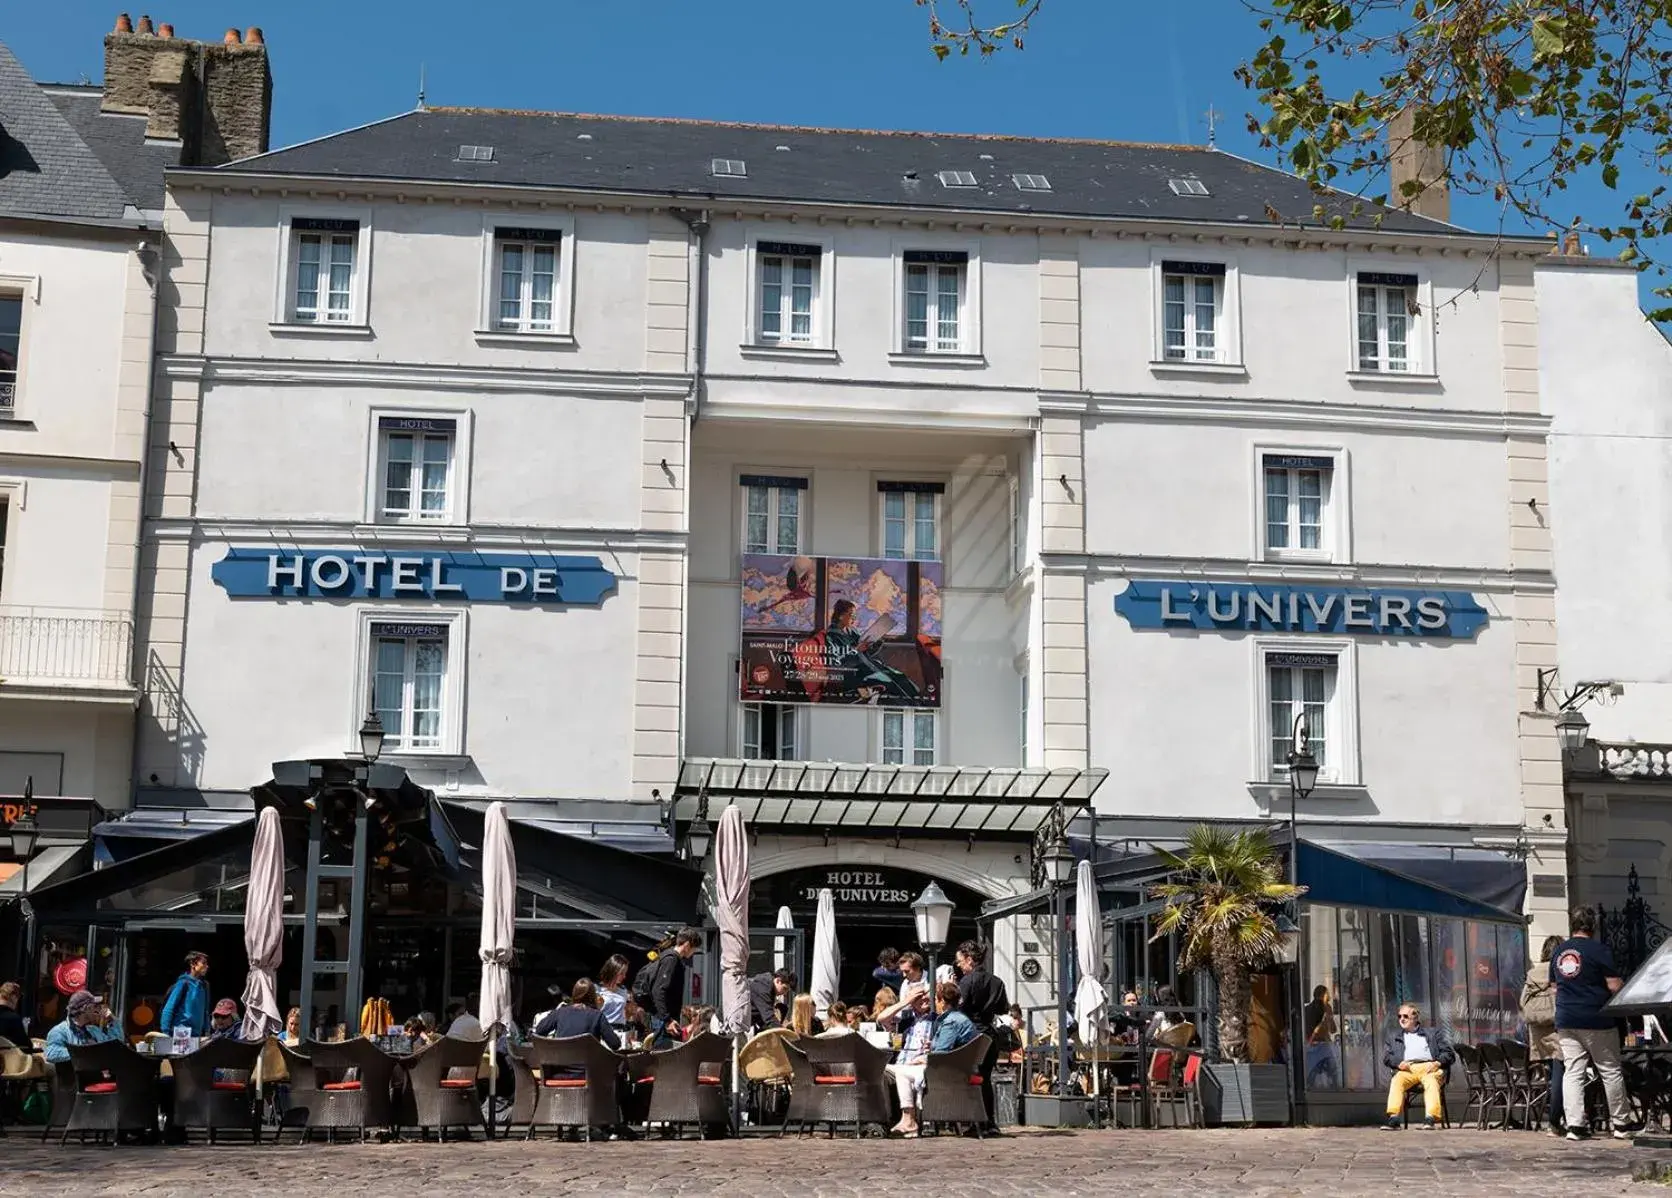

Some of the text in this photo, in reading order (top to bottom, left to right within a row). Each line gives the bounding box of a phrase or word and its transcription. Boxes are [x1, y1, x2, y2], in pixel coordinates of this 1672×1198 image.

[401, 419, 433, 429] HOTEL
[1282, 457, 1312, 466] HOTEL
[267, 554, 558, 594] HOTEL DE
[1160, 588, 1447, 629] L'UNIVERS
[381, 625, 440, 636] L'UNIVERS
[783, 635, 858, 658] Étonnants
[769, 649, 842, 670] Voyageurs
[827, 872, 885, 886] HOTEL
